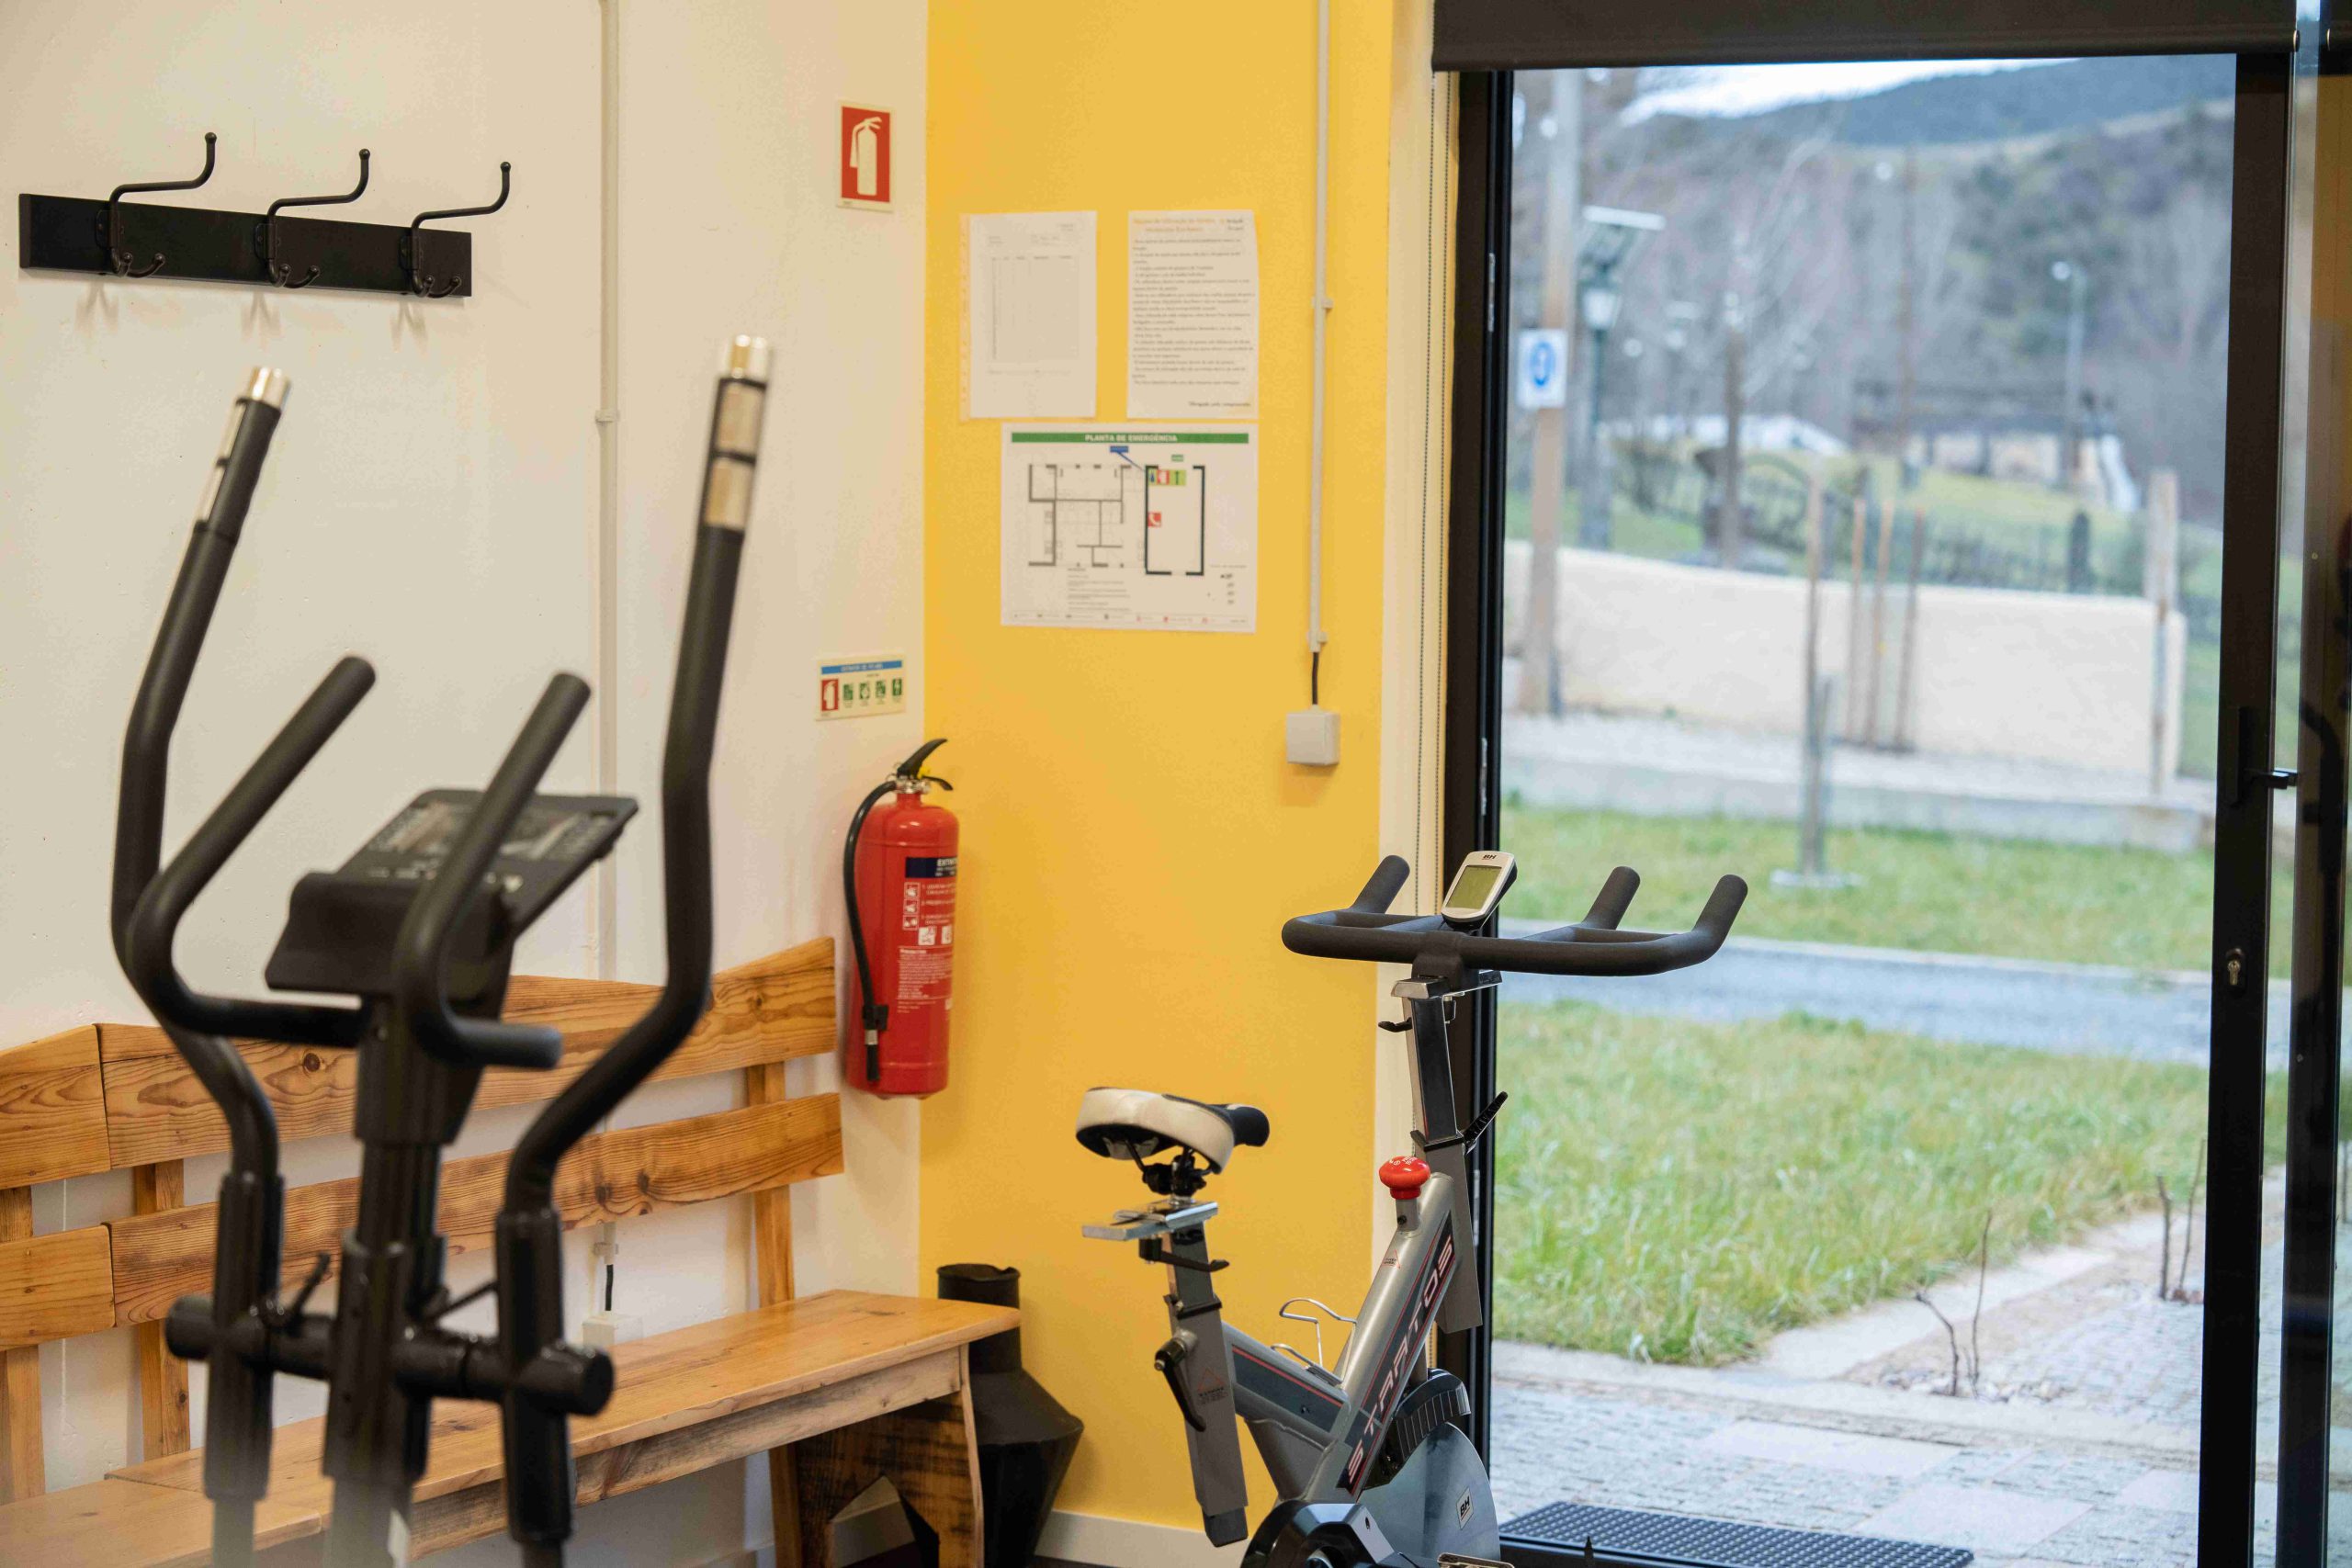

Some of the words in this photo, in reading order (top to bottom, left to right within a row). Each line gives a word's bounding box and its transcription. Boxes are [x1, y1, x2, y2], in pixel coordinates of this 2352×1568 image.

[1084, 434, 1114, 442] PLANTA
[1116, 434, 1126, 442] DE
[1348, 1235, 1453, 1483] STRATOS
[1460, 1495, 1470, 1517] BH
